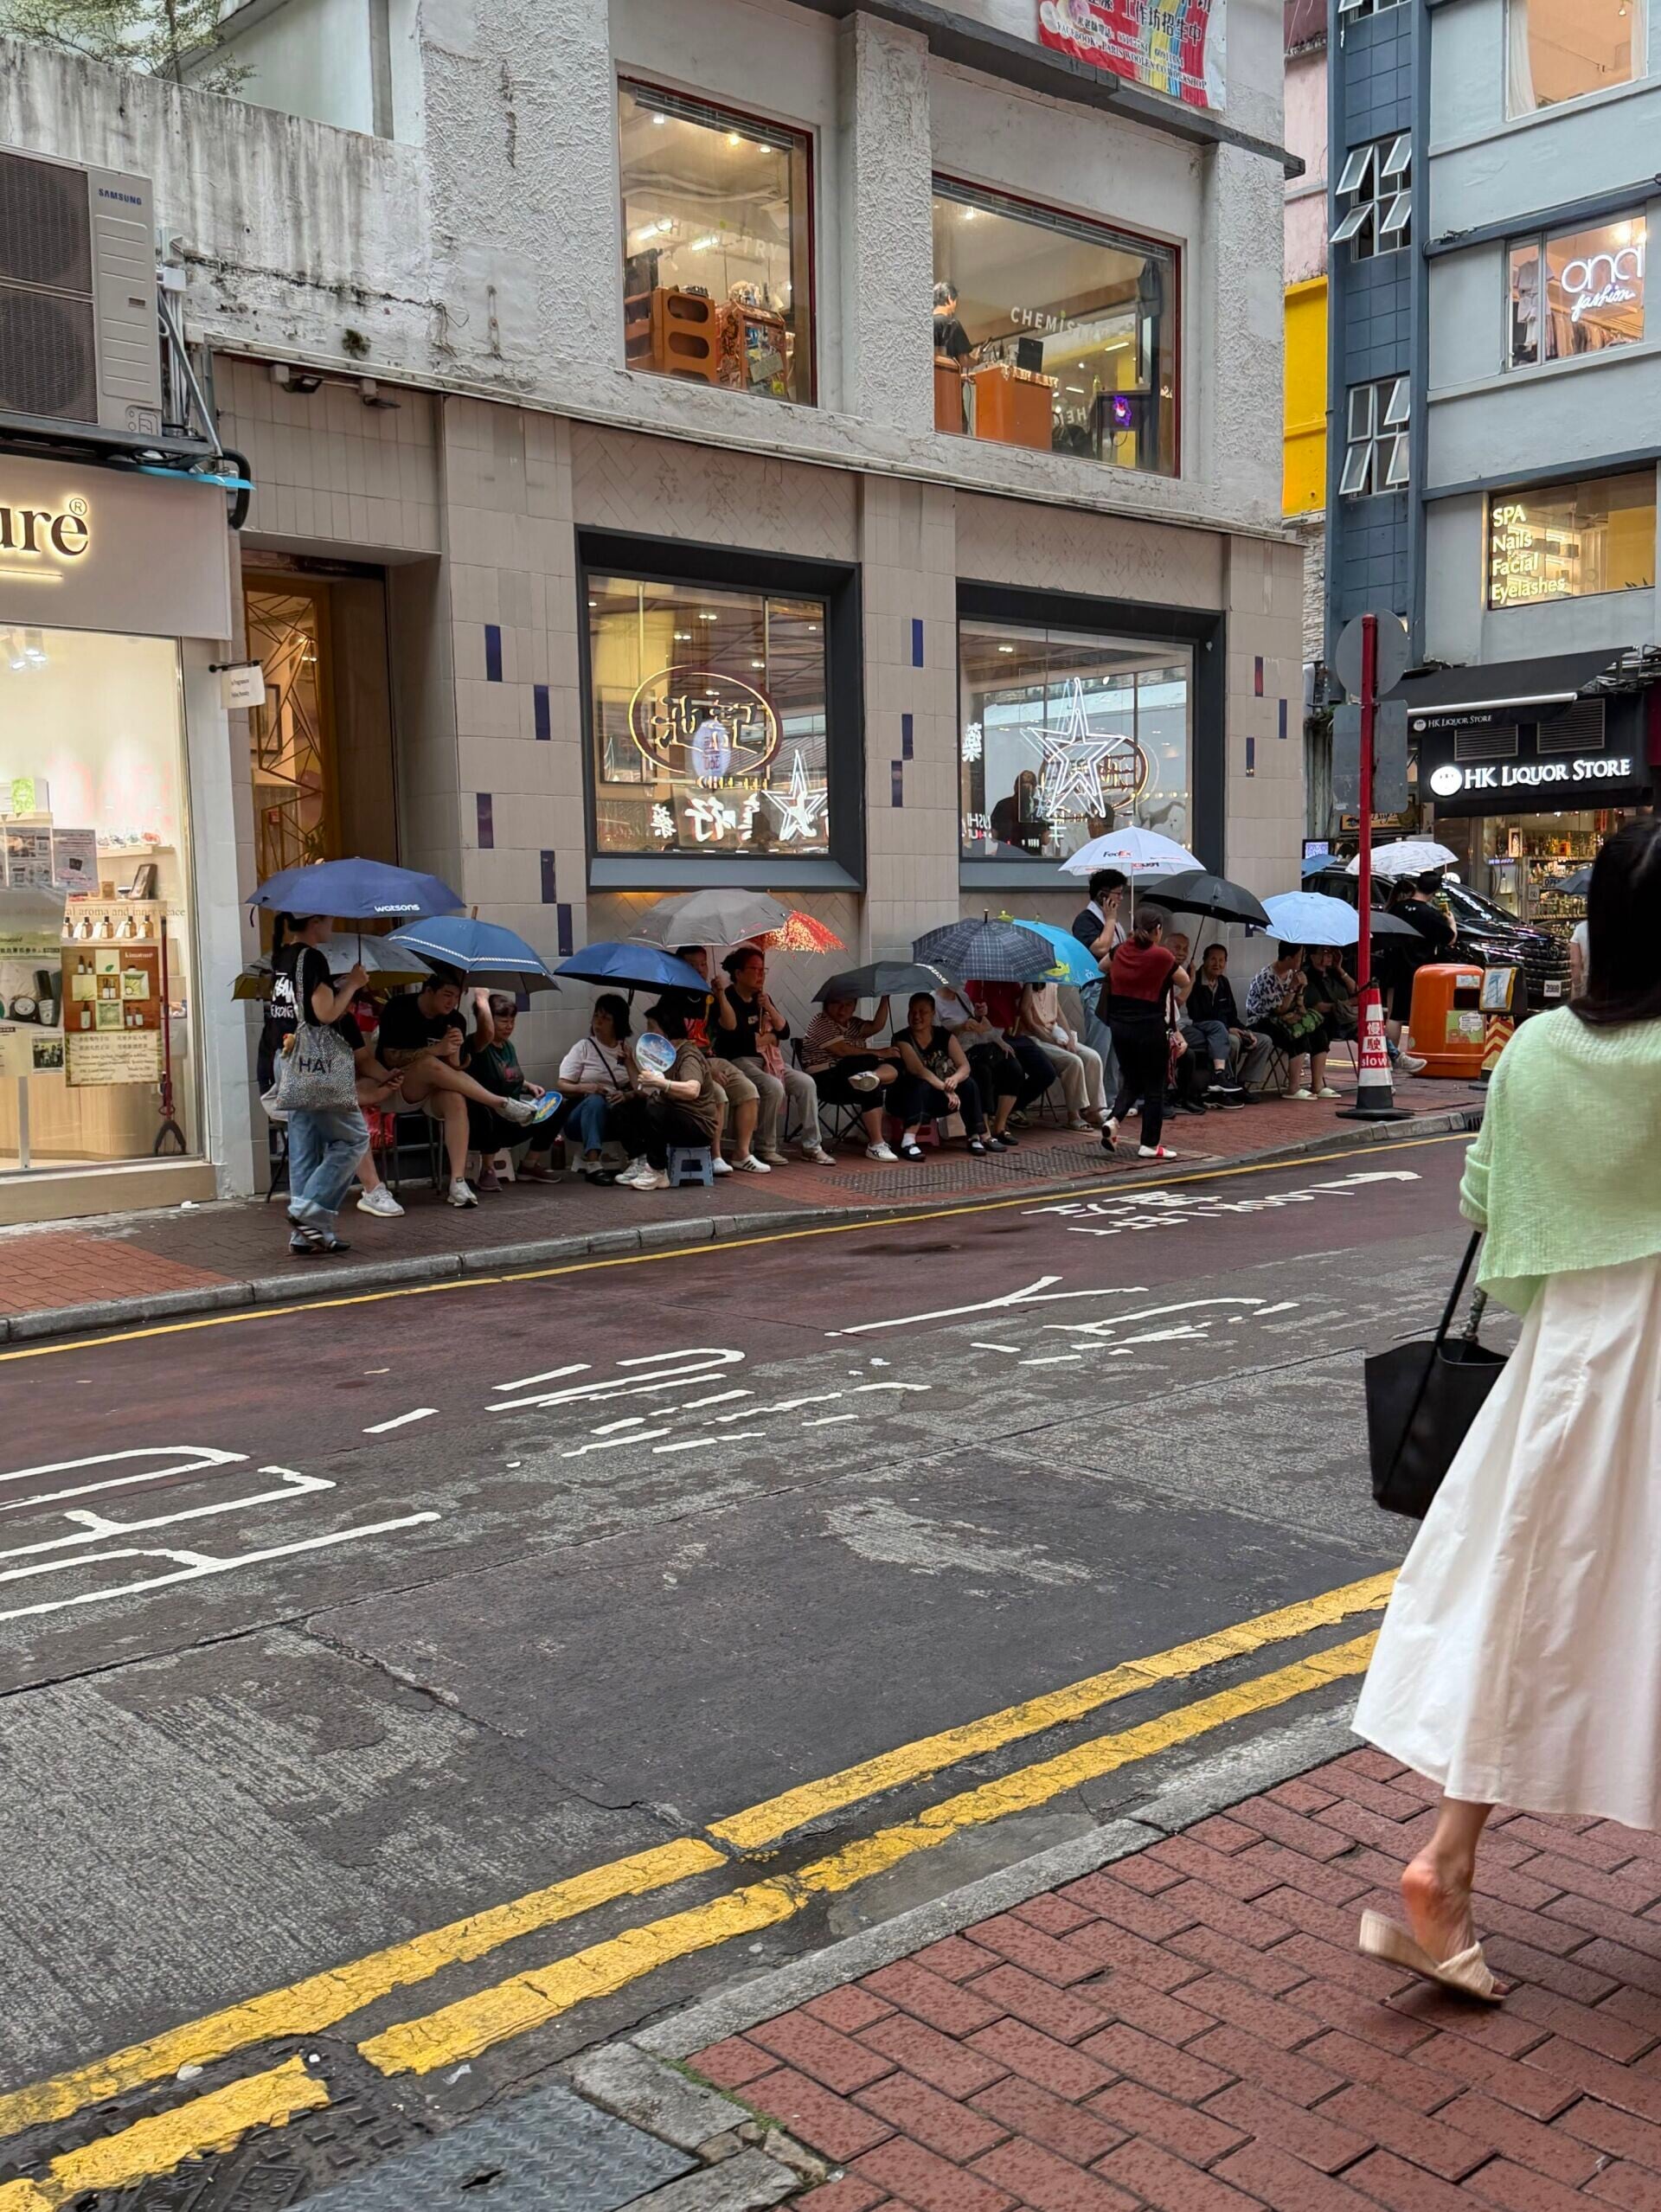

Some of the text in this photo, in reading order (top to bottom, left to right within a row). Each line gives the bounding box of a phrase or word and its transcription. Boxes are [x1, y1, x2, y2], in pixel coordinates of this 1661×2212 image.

[1124, 0, 1202, 46] 工作坊招生中
[1101, 41, 1125, 58] PARIS
[1125, 49, 1155, 69] WOOLEN
[1167, 67, 1207, 89] WORKSHOP
[99, 188, 142, 205] SAMSUNG
[1561, 246, 1642, 293] ona
[1571, 284, 1636, 323] fashion
[1492, 504, 1526, 527] SPA
[1492, 529, 1532, 553] Nails
[1492, 551, 1538, 576] Facial
[1491, 576, 1566, 605] Eyelashes
[1427, 715, 1491, 728] HK LIQUOR STORE
[1464, 758, 1632, 790] HK LIQUOR STORE
[80, 908, 109, 917] aroma
[112, 906, 130, 917] and
[374, 903, 420, 913] watsons
[1361, 1054, 1388, 1067] slow
[1067, 1188, 1356, 1236] LOOK LEFT
